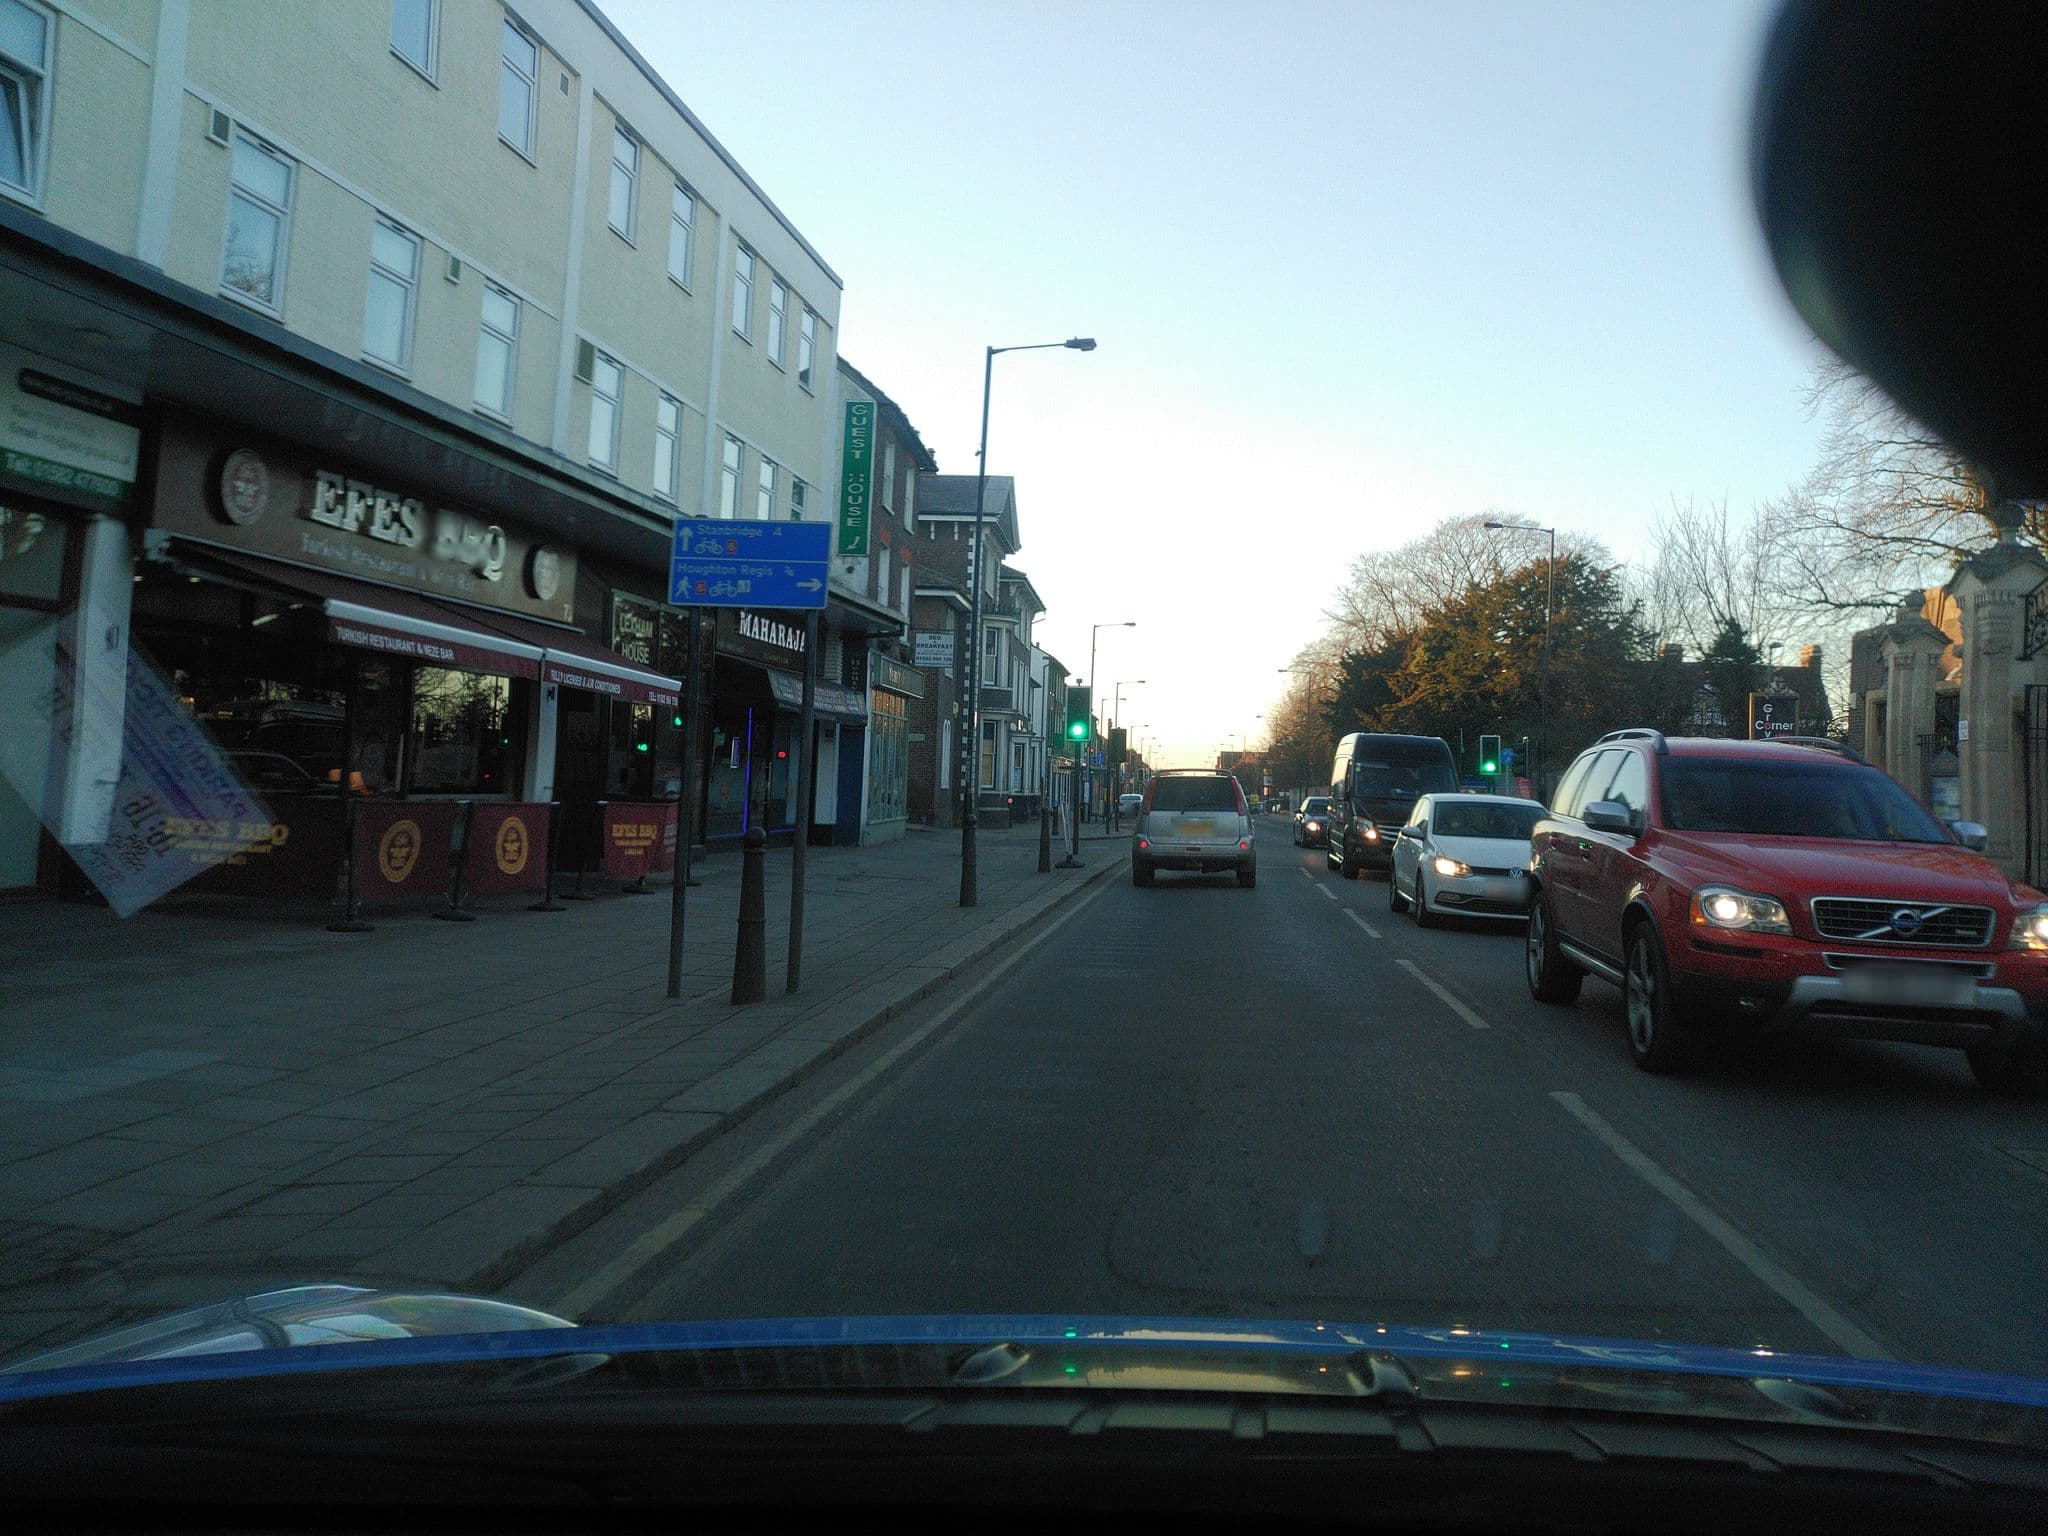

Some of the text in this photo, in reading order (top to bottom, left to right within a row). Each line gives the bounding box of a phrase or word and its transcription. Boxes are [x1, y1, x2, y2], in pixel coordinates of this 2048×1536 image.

[847, 403, 867, 527] GUEST HOUSE
[310, 468, 423, 548] EFES
[696, 524, 763, 538] Stanbridge
[678, 563, 738, 576] Houghton
[740, 564, 774, 577] Regis
[370, 633, 414, 653] RESTAURANT
[621, 642, 650, 664] HOUSE
[1754, 720, 1794, 731] Corner
[612, 823, 638, 838] EFES
